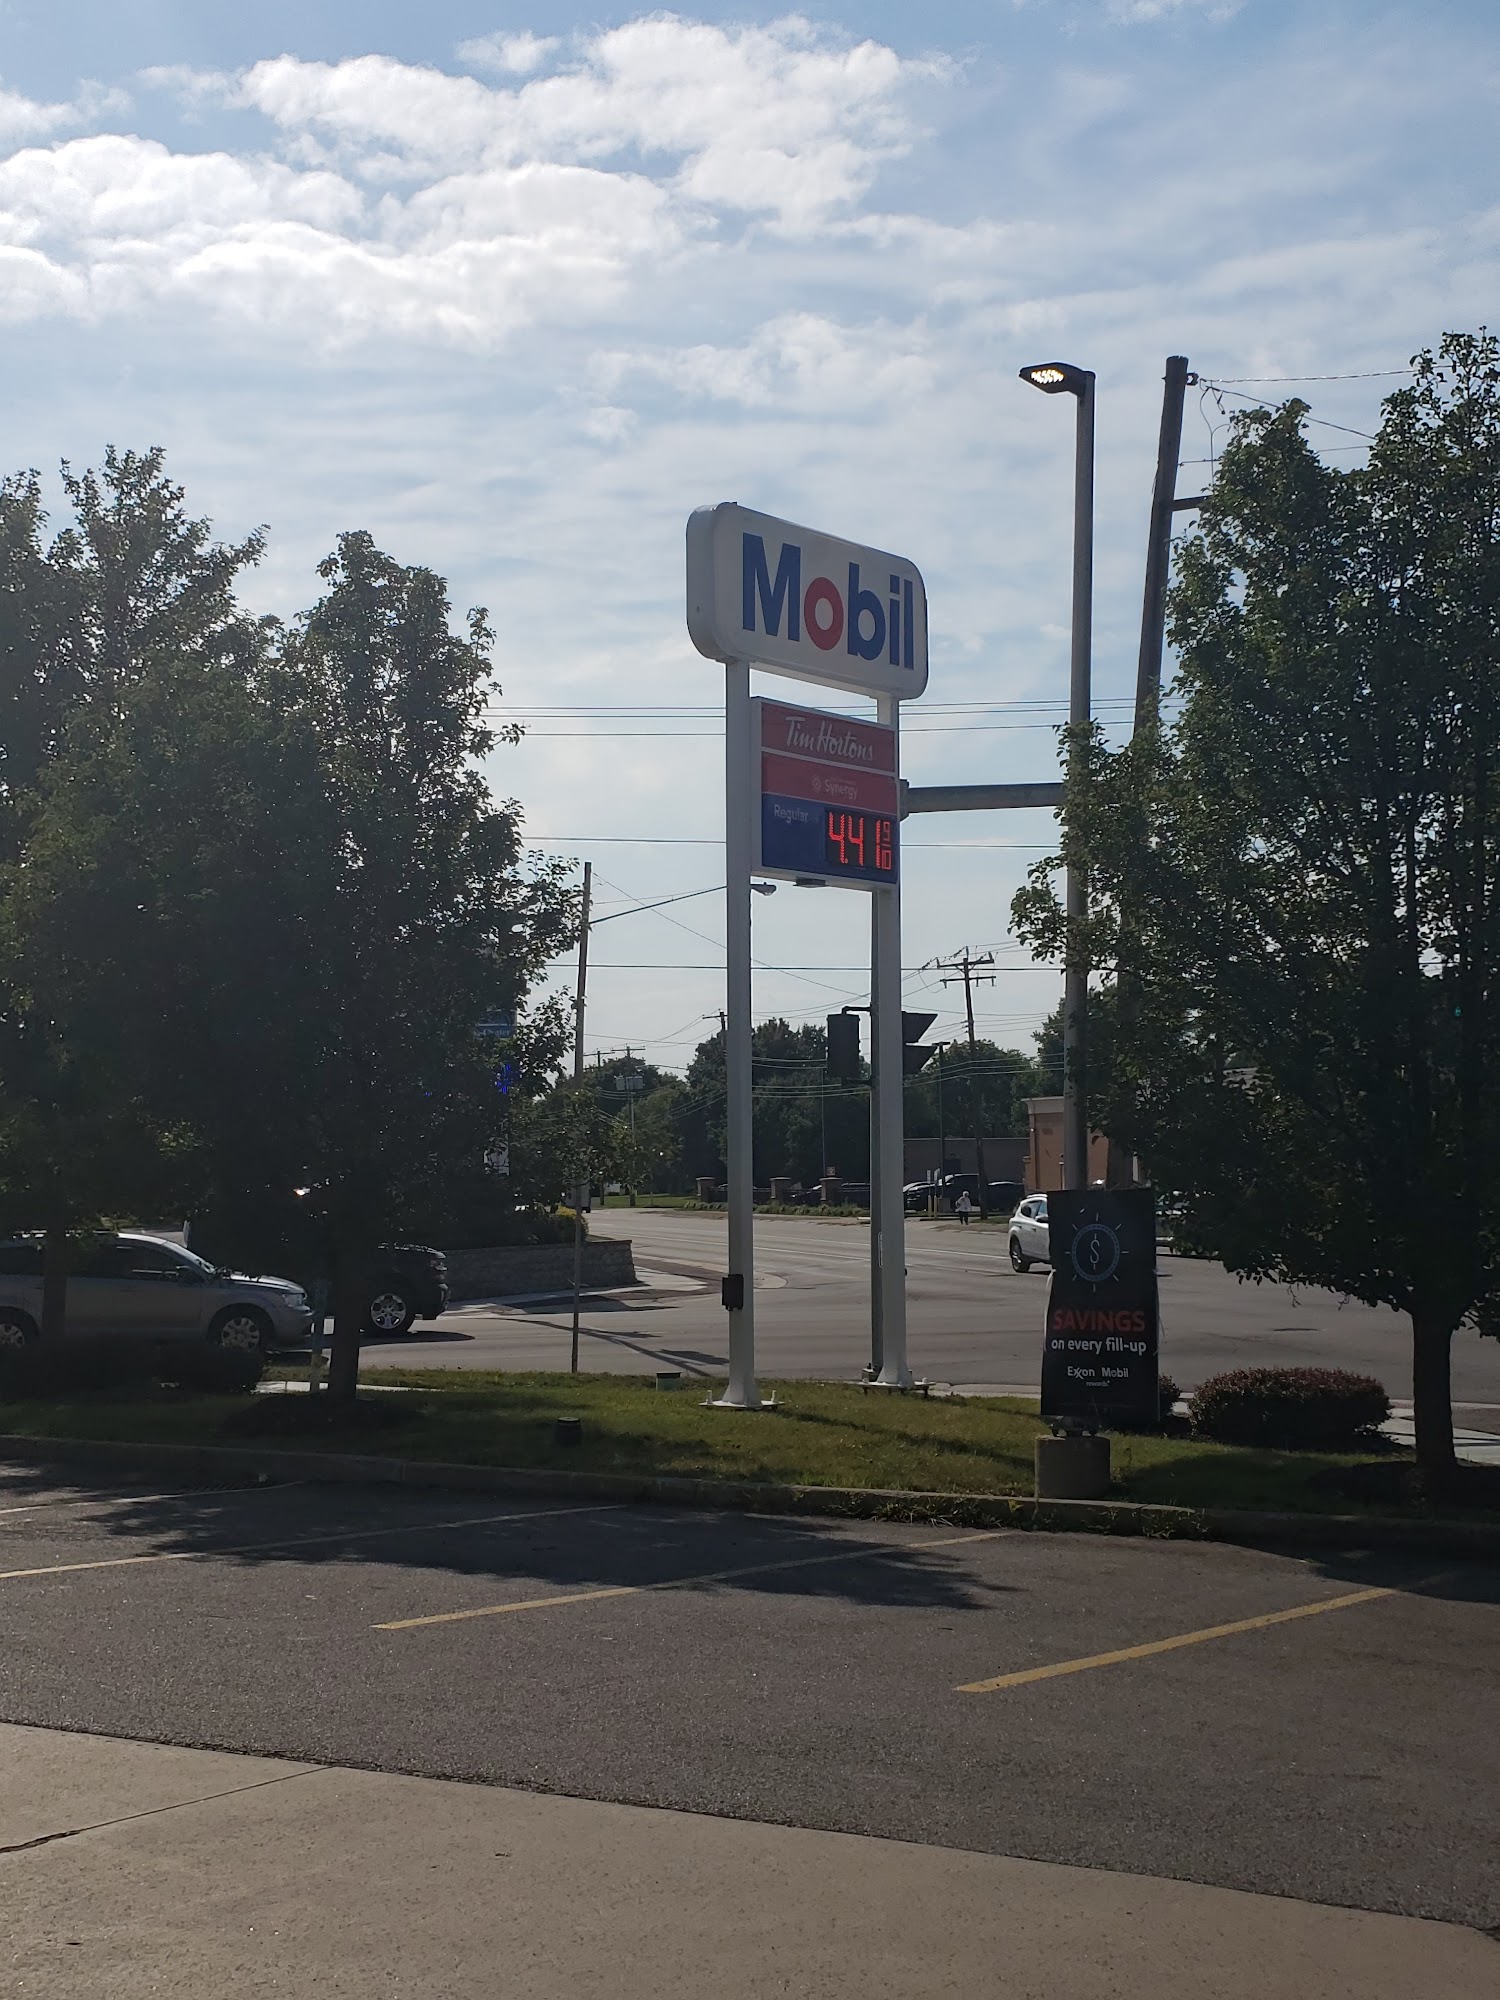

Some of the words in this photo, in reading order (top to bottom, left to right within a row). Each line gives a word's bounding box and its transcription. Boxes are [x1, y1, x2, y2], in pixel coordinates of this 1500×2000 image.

[742, 532, 915, 671] Mobil
[785, 716, 814, 751] Tim
[816, 720, 874, 761] Hortons
[824, 779, 858, 800] Synergy
[774, 803, 809, 823] Regular
[828, 811, 881, 869] 4.41
[1053, 1309, 1146, 1333] SAVINGS
[1051, 1339, 1065, 1350] on
[1068, 1339, 1103, 1355] every
[1105, 1336, 1147, 1356] fill-up
[1067, 1366, 1095, 1380] Exxon
[1101, 1367, 1129, 1378] Mobil
